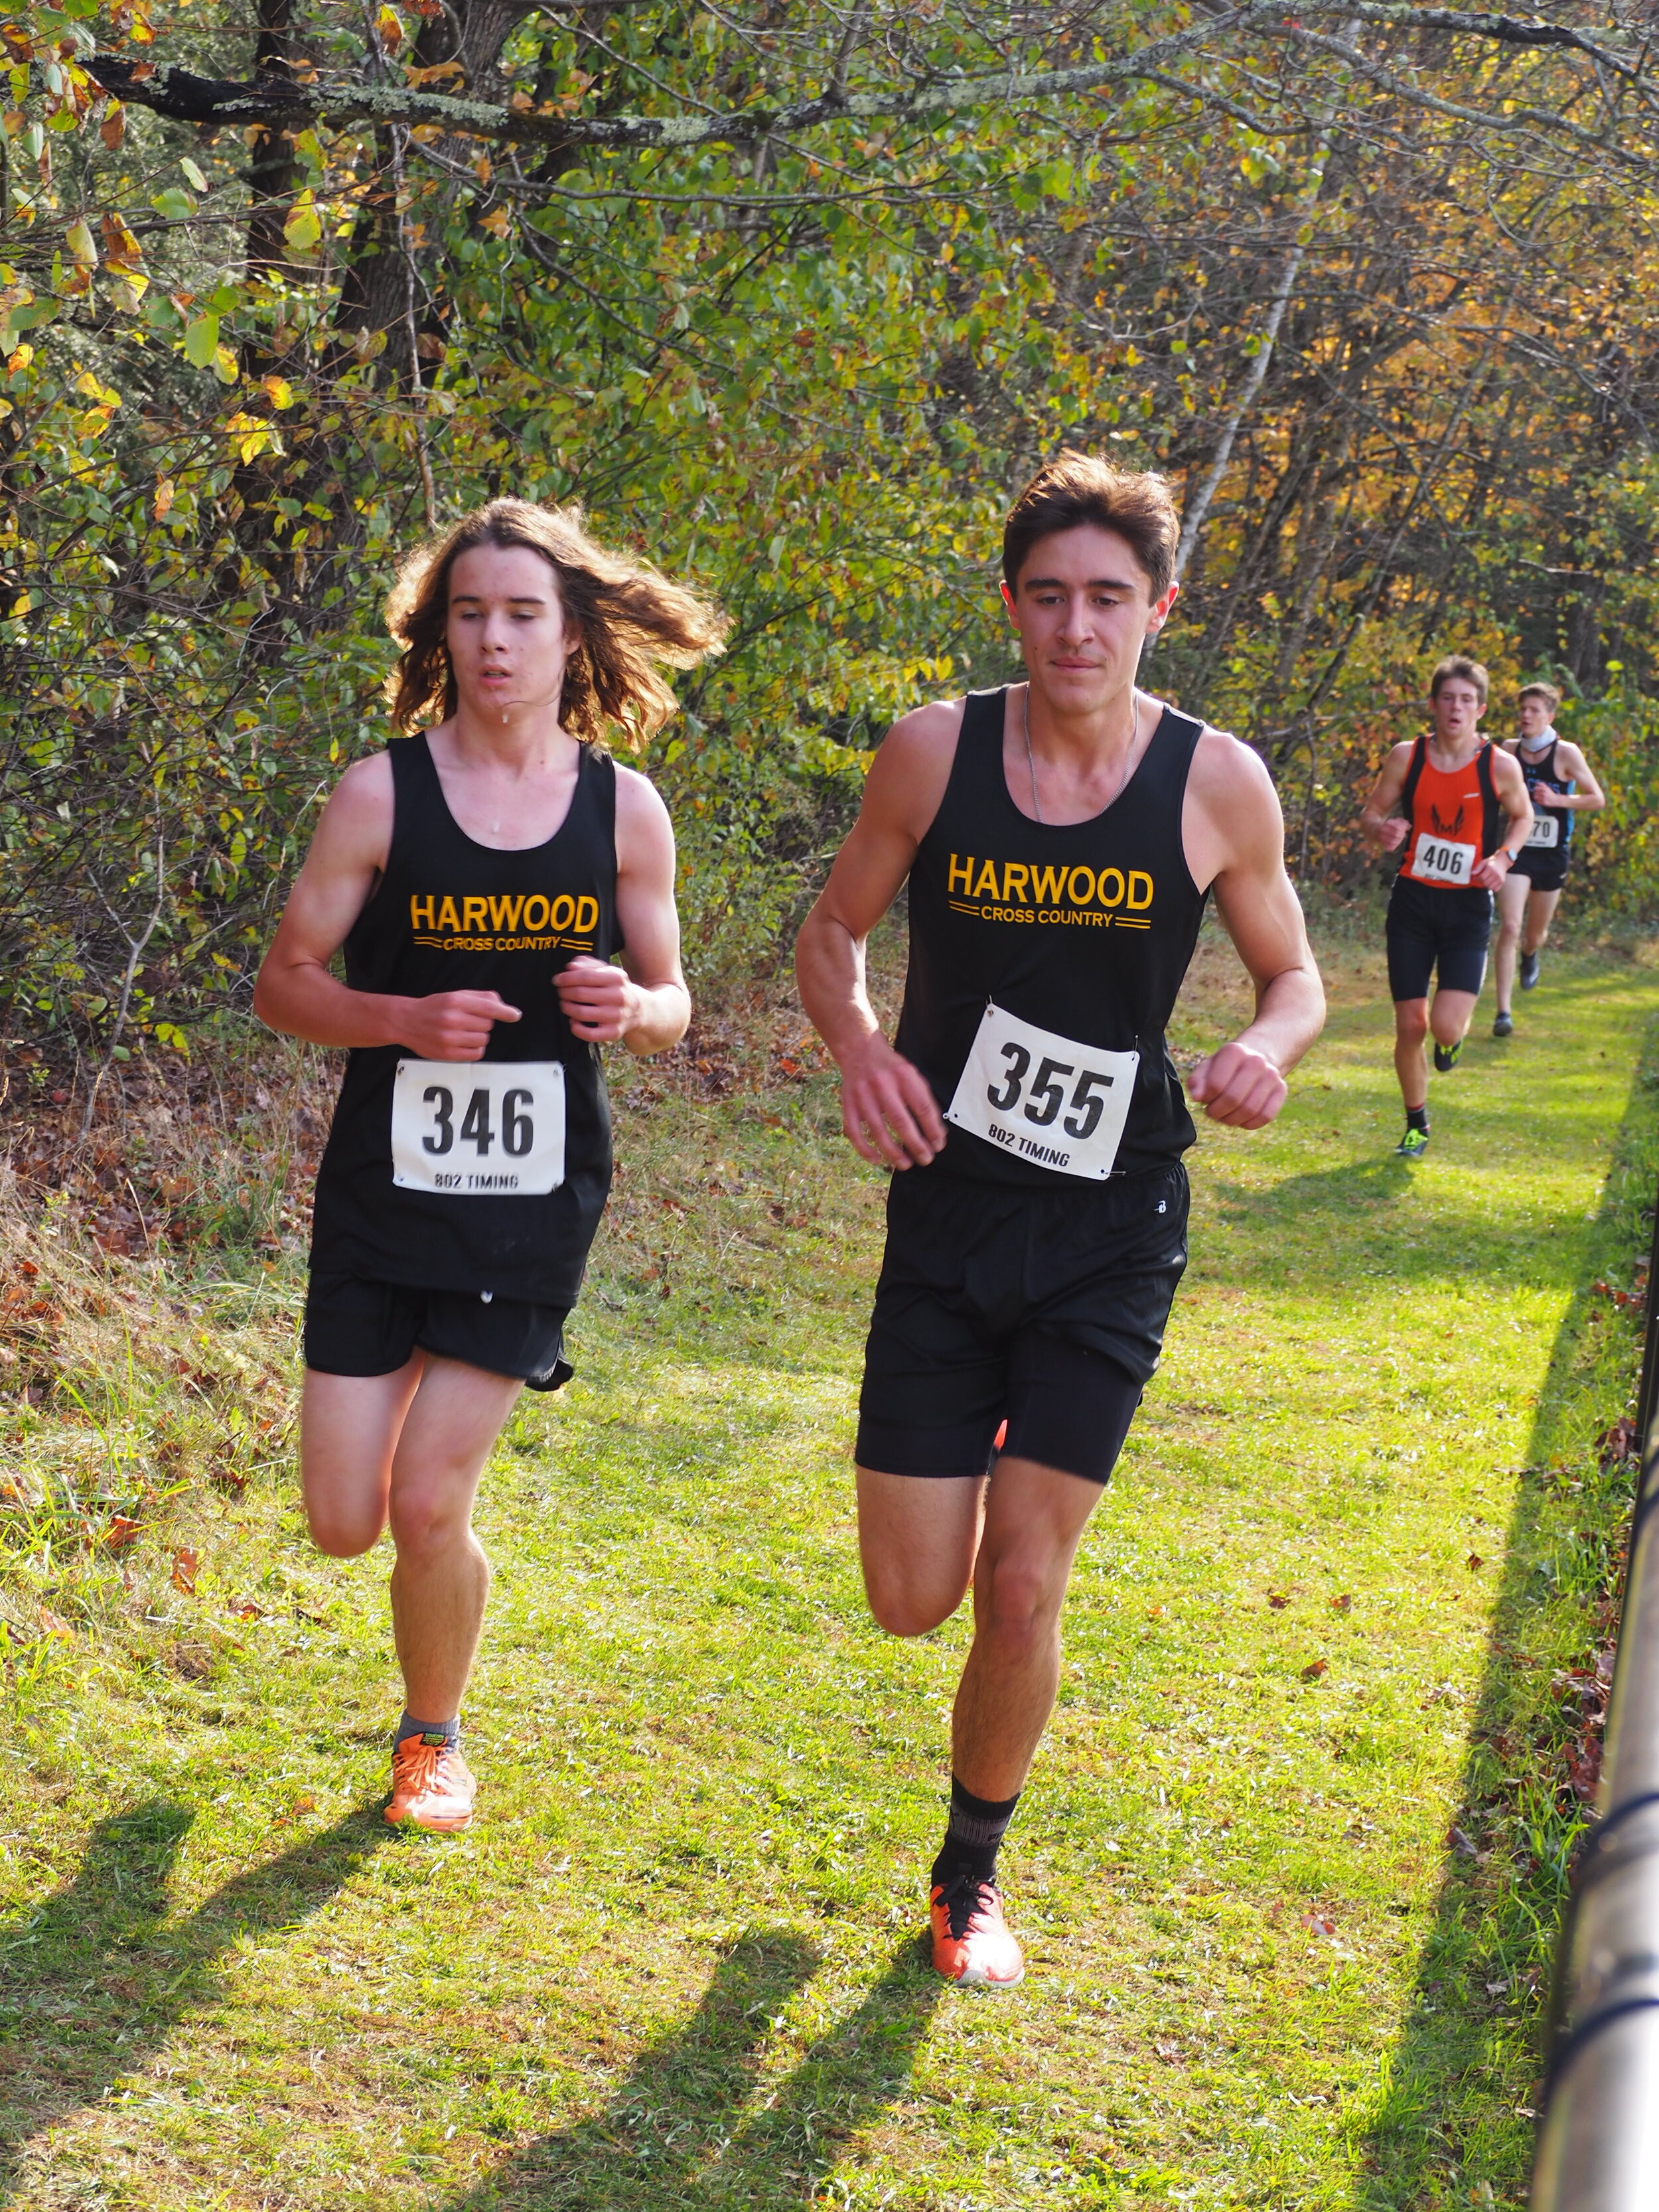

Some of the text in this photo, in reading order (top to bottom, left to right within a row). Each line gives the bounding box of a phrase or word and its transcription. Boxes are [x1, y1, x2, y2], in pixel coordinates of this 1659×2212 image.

[1531, 820, 1550, 838] 70
[1423, 845, 1463, 875] 406
[948, 853, 1153, 910] HARWOOD
[410, 895, 599, 932] HARWOOD
[981, 906, 1114, 926] CROSS COUNTRY
[443, 936, 561, 951] CROSS COUNTRY
[987, 1042, 1114, 1140] 355
[422, 1086, 534, 1157] 346
[988, 1124, 1070, 1167] 802 TIMING
[435, 1173, 518, 1189] 802 TIMING
